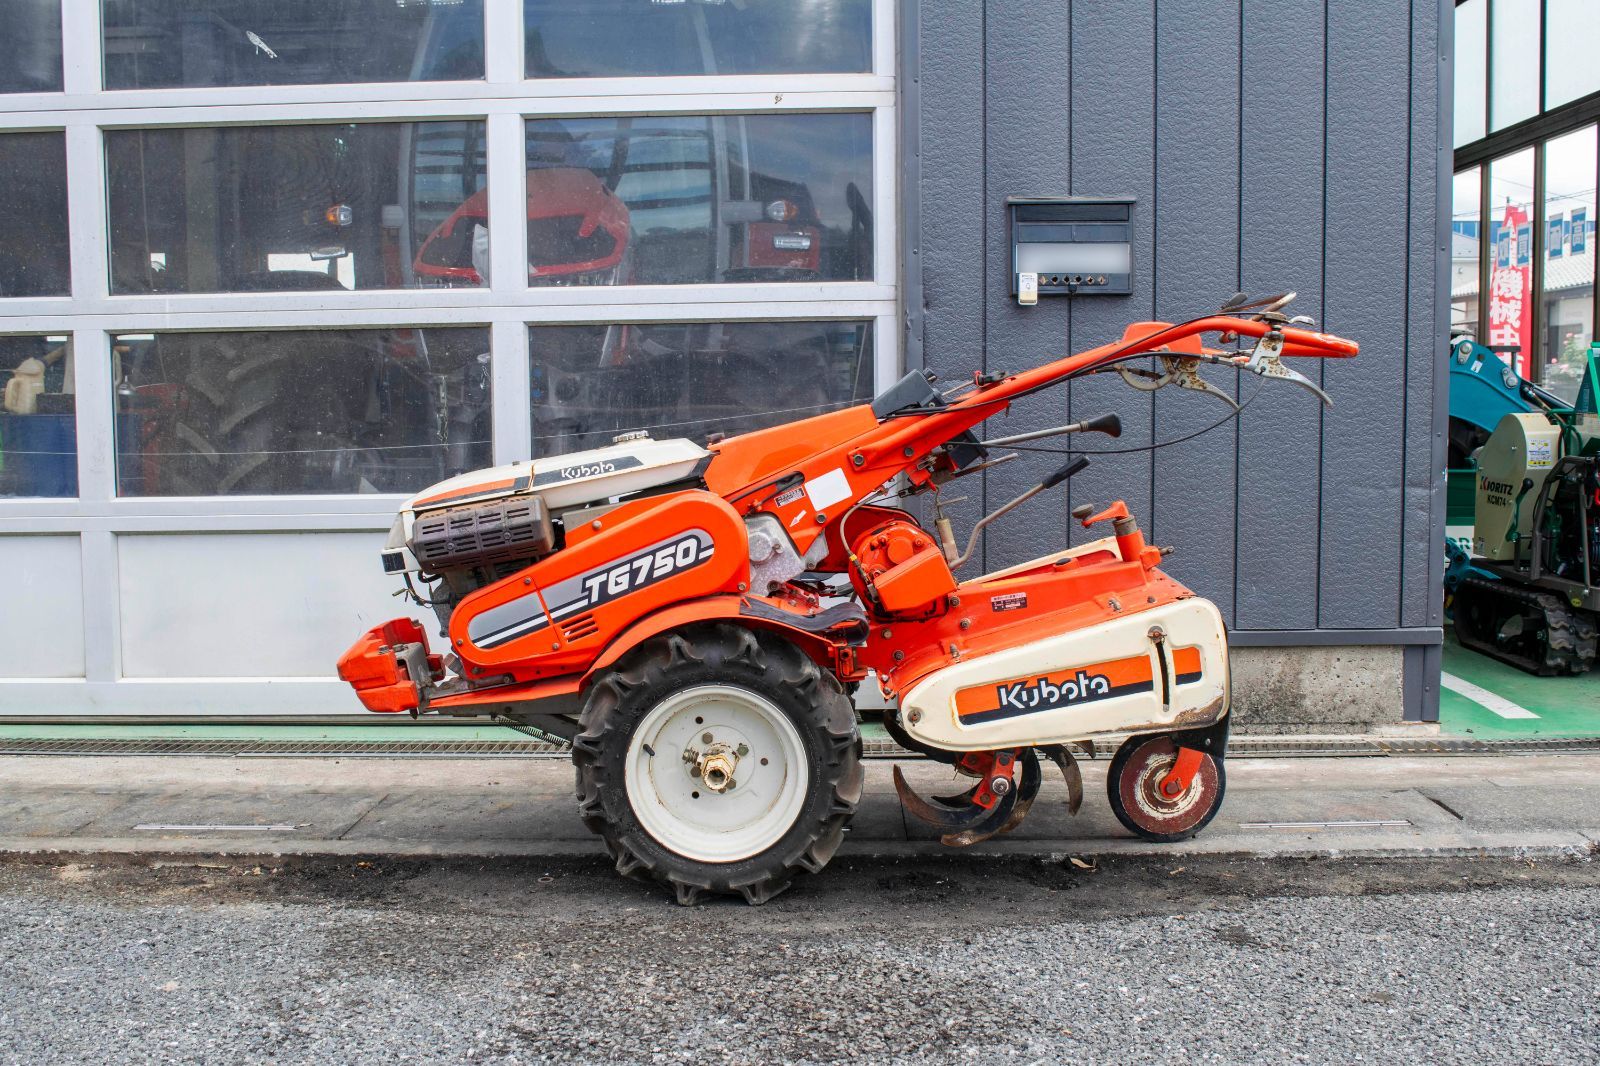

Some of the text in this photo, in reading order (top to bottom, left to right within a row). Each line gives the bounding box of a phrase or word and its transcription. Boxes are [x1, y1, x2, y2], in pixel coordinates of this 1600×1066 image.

[561, 461, 615, 479] Kubota
[1480, 475, 1514, 496] KIORITZ
[585, 537, 698, 604] TG750
[1000, 672, 1110, 709] Kubota
